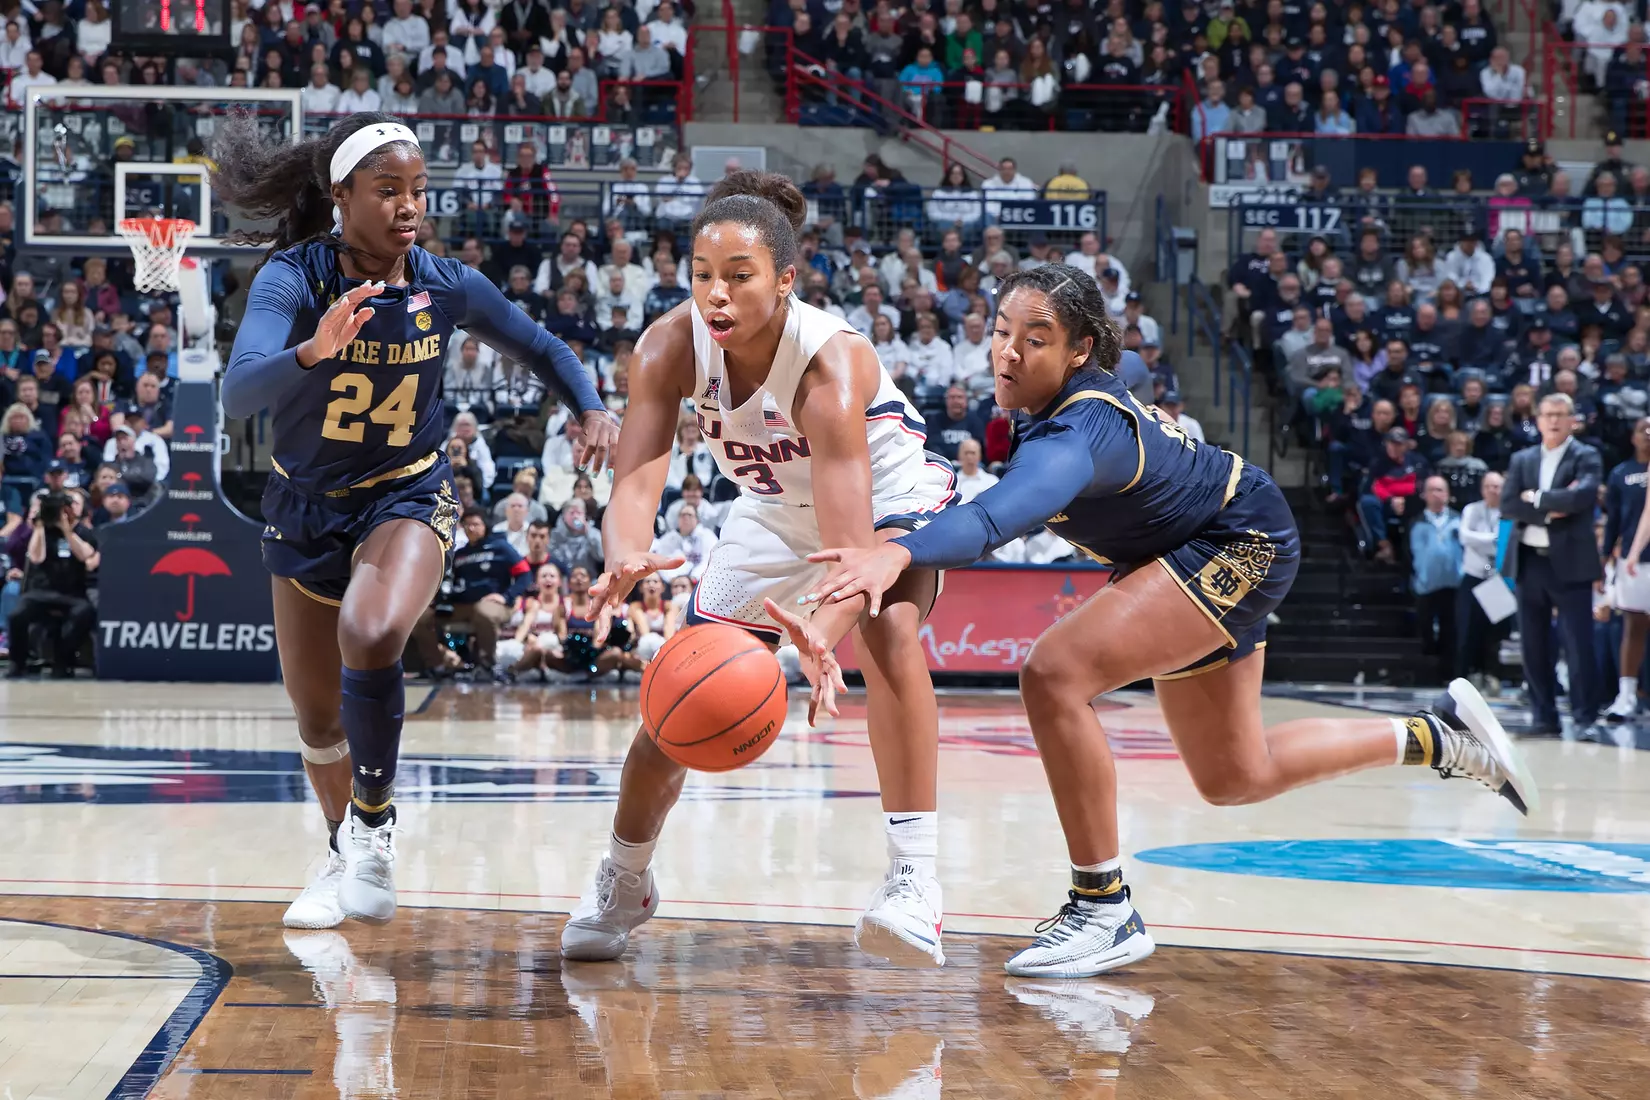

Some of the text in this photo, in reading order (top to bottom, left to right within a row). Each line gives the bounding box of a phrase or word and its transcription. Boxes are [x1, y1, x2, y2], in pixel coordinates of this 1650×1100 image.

[427, 190, 459, 214] 16
[1001, 204, 1097, 228] SEC 116
[1244, 207, 1342, 231] SEC 117
[340, 333, 440, 365] TRE DAME
[321, 372, 420, 447] 24
[170, 441, 215, 452] TRAVELERS
[697, 412, 811, 464] UONN
[733, 463, 784, 496] 3
[168, 489, 213, 501] TRAVELERS
[167, 530, 212, 541] TRAVELERS
[99, 620, 275, 652] TRAVELERS
[732, 720, 776, 756] UCONN
